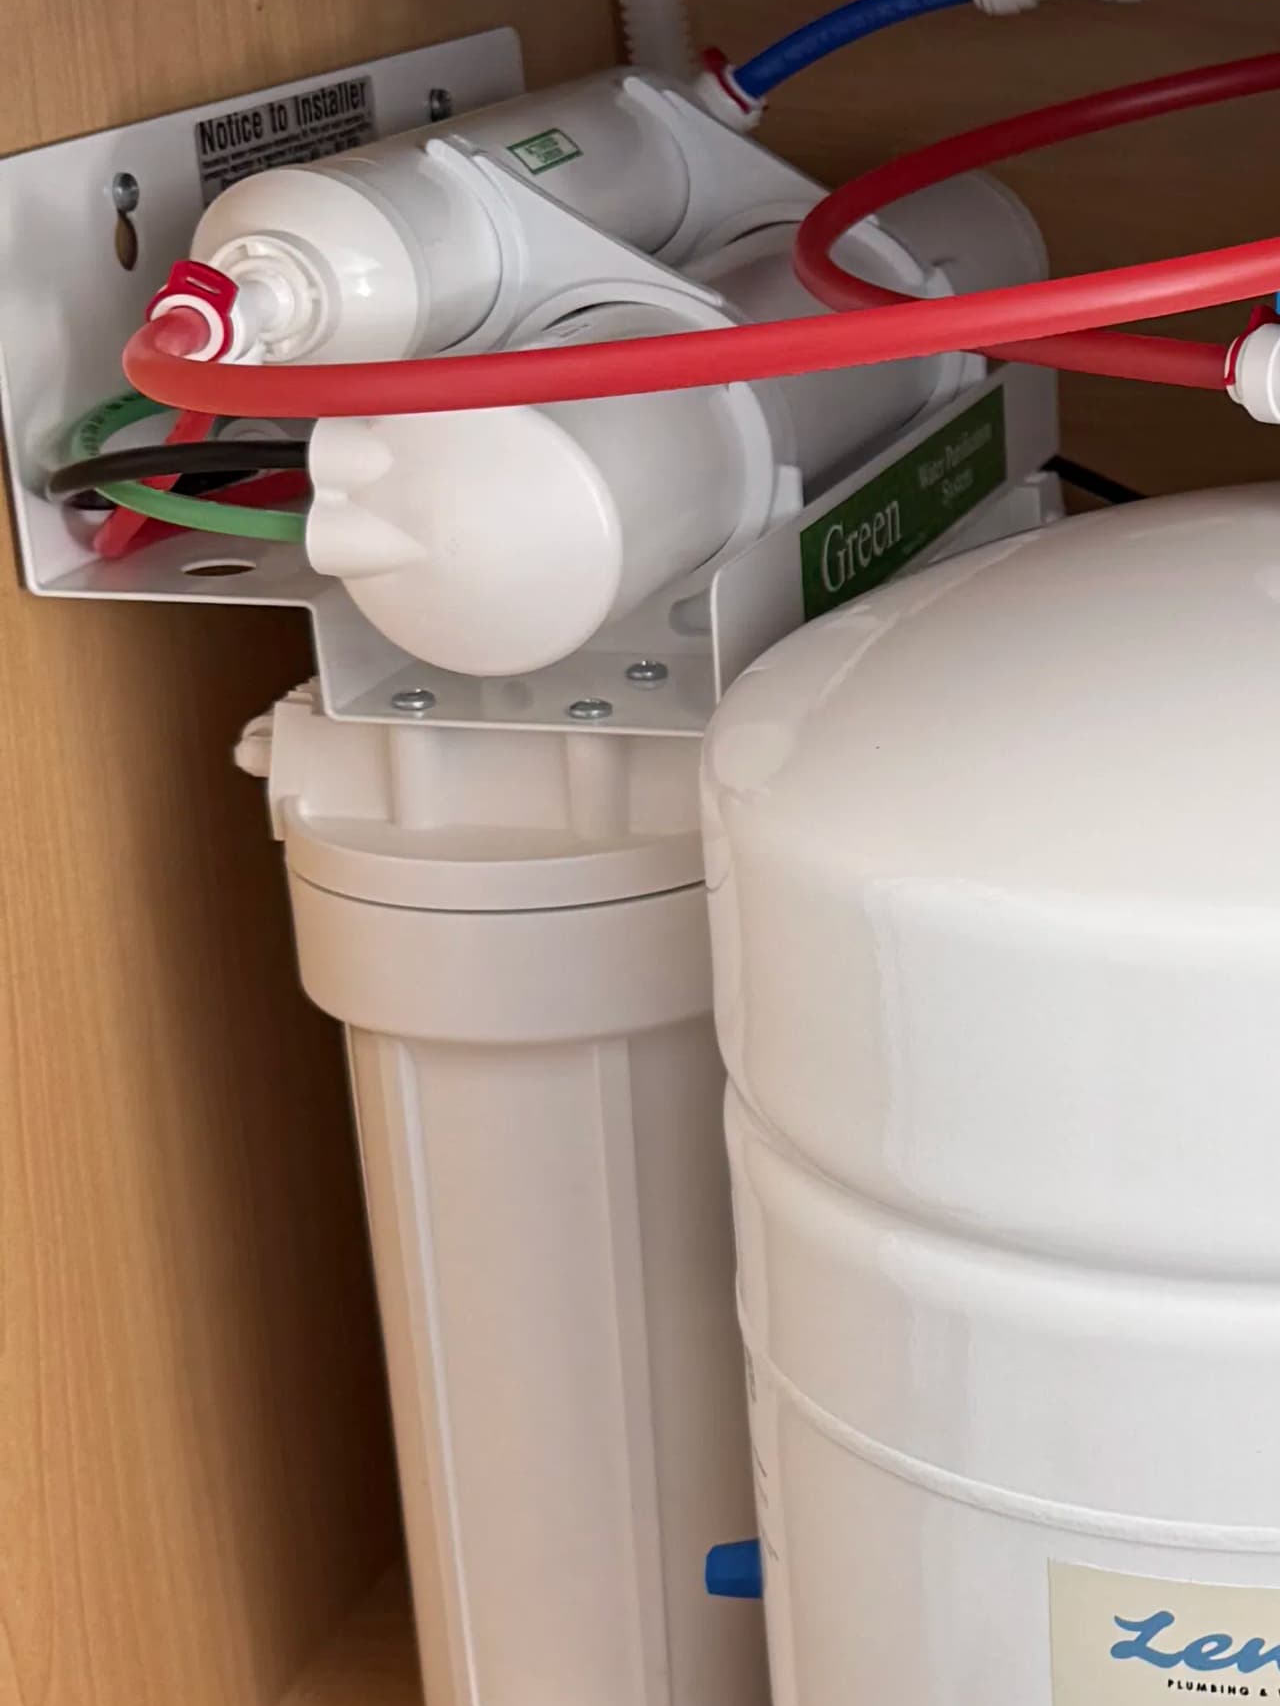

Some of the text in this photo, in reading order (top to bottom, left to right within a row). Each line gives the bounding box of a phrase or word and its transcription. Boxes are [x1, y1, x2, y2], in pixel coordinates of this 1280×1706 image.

[200, 111, 264, 155] Notice
[270, 102, 289, 134] to
[294, 81, 367, 125] Installer
[822, 500, 900, 592] Green
[1167, 1679, 1250, 1696] PLUMBING
[1259, 1688, 1268, 1697] &
